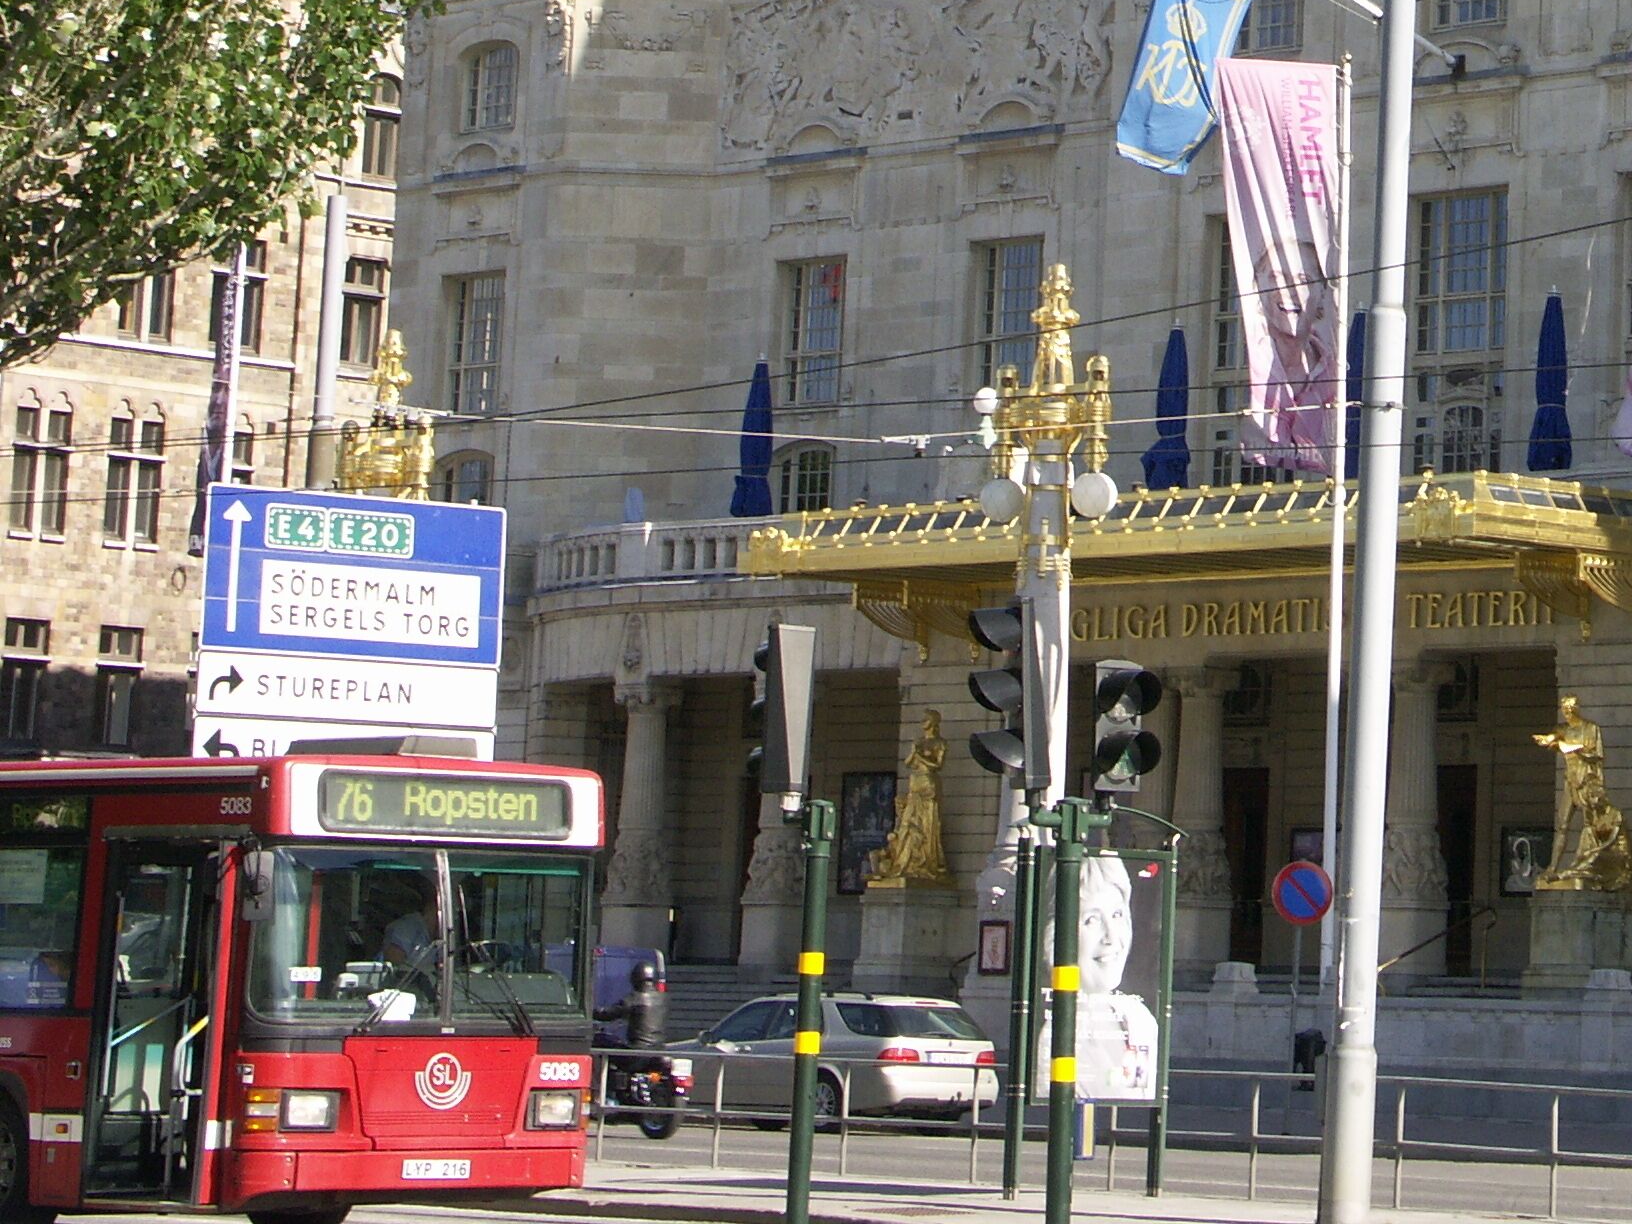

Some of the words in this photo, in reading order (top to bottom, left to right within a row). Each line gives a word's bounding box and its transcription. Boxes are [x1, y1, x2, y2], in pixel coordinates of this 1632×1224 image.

[1297, 79, 1323, 206] HAMLET
[271, 568, 436, 606] SÖDERMALM
[270, 604, 386, 632] SERGELS
[403, 612, 470, 638] TORG
[1070, 603, 1168, 642] GLIGA
[1180, 598, 1333, 638] DRAMATI
[257, 674, 413, 704] STUREPLAN
[220, 797, 251, 815] 5083
[336, 779, 374, 822] 76
[404, 781, 538, 825] Ropsten
[432, 1063, 455, 1086] SL
[539, 1061, 580, 1082] 5083
[405, 1163, 432, 1177] LYP
[442, 1162, 467, 1177] 216
